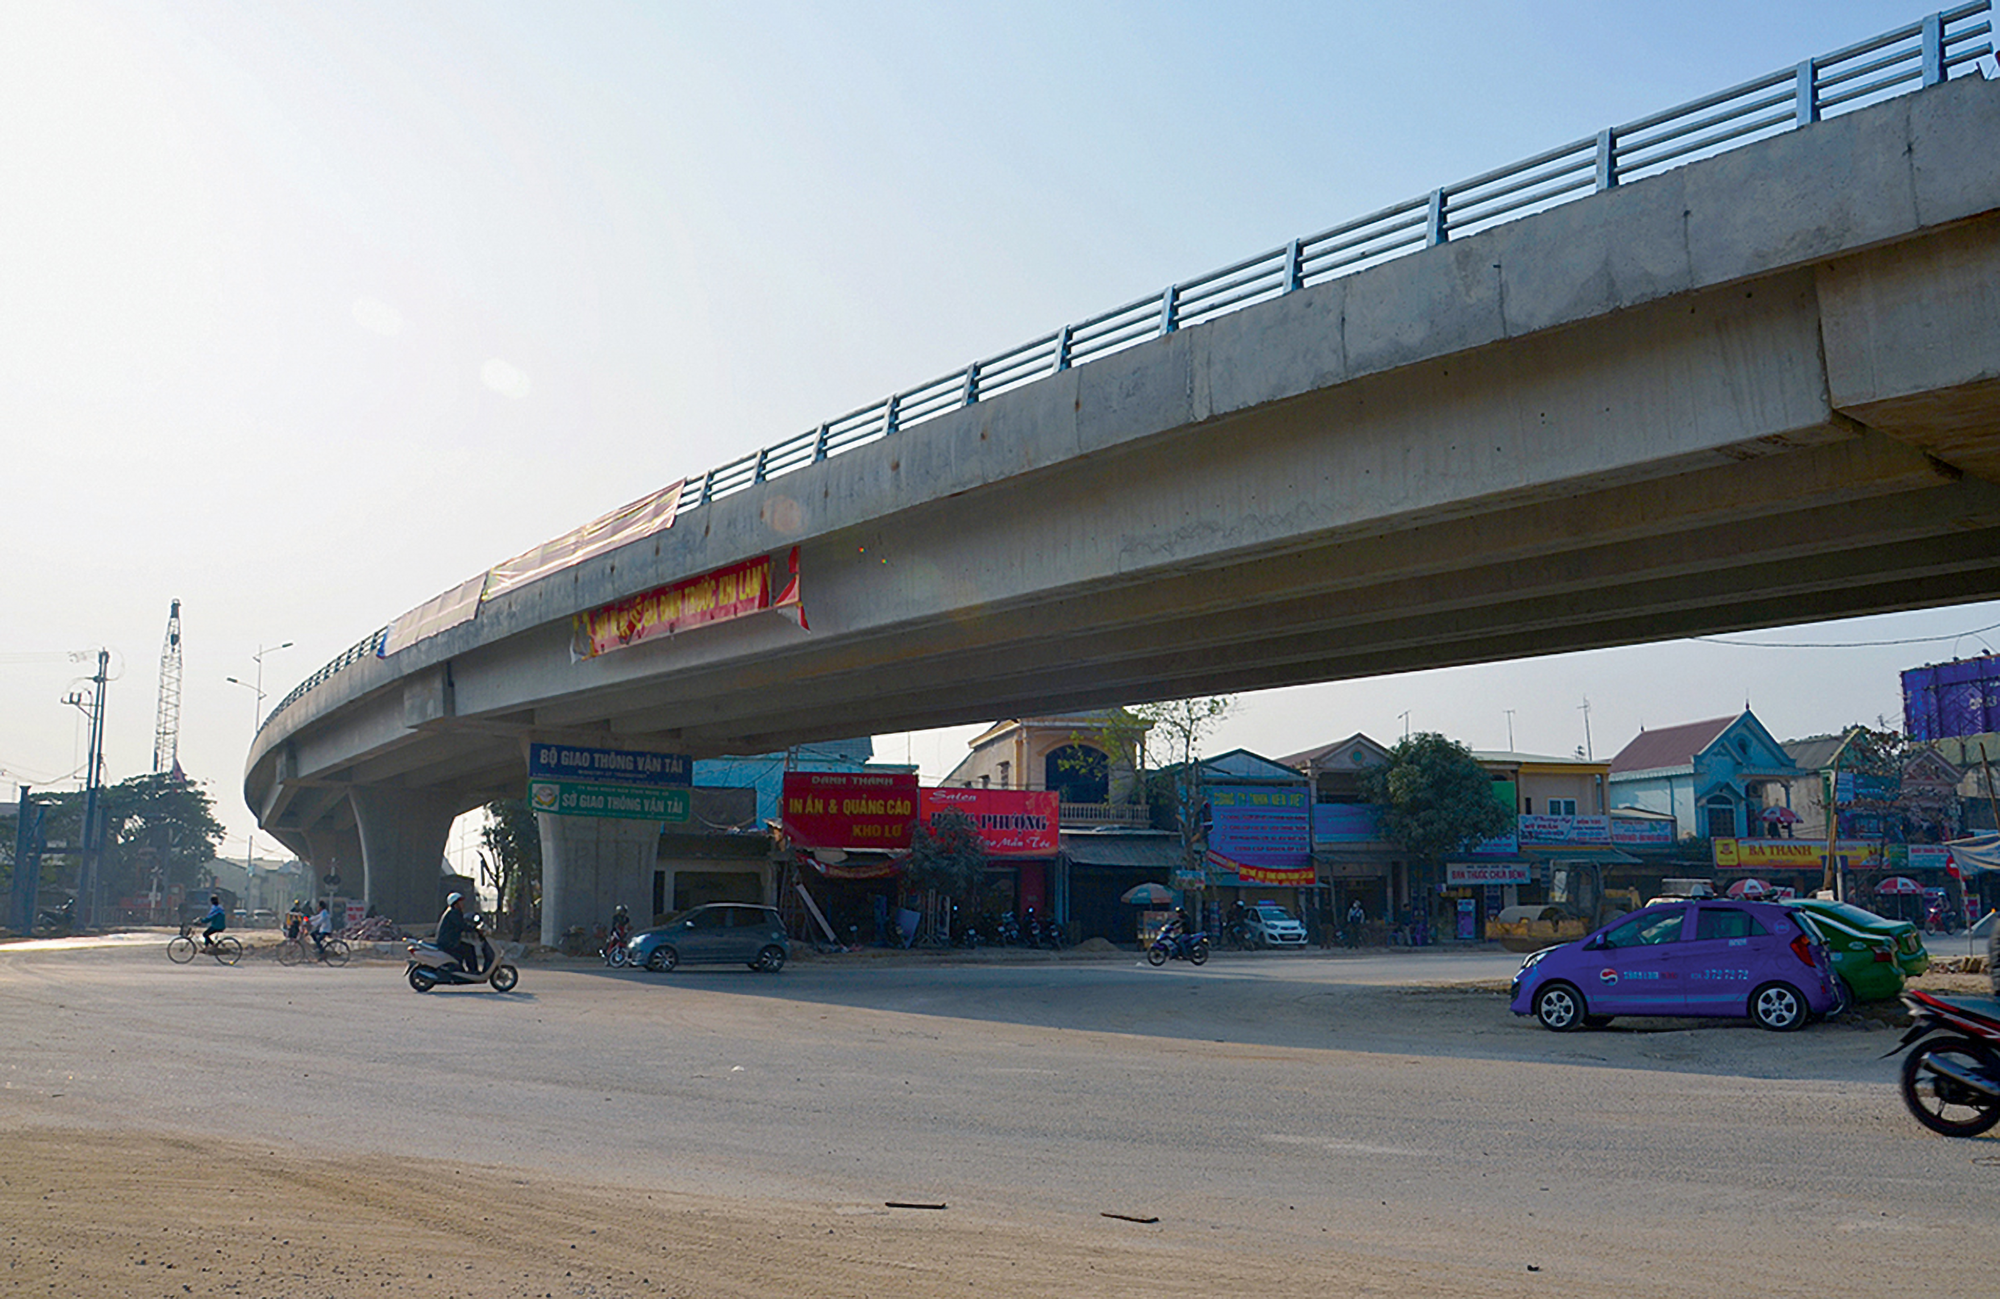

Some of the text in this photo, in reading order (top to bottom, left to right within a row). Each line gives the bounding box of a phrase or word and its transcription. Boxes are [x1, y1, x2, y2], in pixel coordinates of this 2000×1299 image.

[719, 573, 737, 607] KHI
[540, 747, 558, 768] BỘ
[561, 751, 590, 767] GIAO
[593, 751, 634, 771] THÔNG
[637, 754, 661, 774] VẬN
[665, 754, 683, 774] TẢI
[562, 789, 579, 807] SỞ
[579, 795, 604, 809] GIAO
[607, 794, 642, 811] THÔNG
[644, 797, 664, 815] VẬN
[667, 797, 683, 814] TẢI
[789, 798, 803, 814] IN
[828, 798, 838, 814] &
[843, 794, 885, 816] QUẢNG
[886, 797, 912, 816] CÁO
[852, 824, 882, 837] KHO
[981, 811, 1048, 836] PHƯỢNG
[1749, 840, 1766, 856] BÀ
[1768, 844, 1812, 856] THANH
